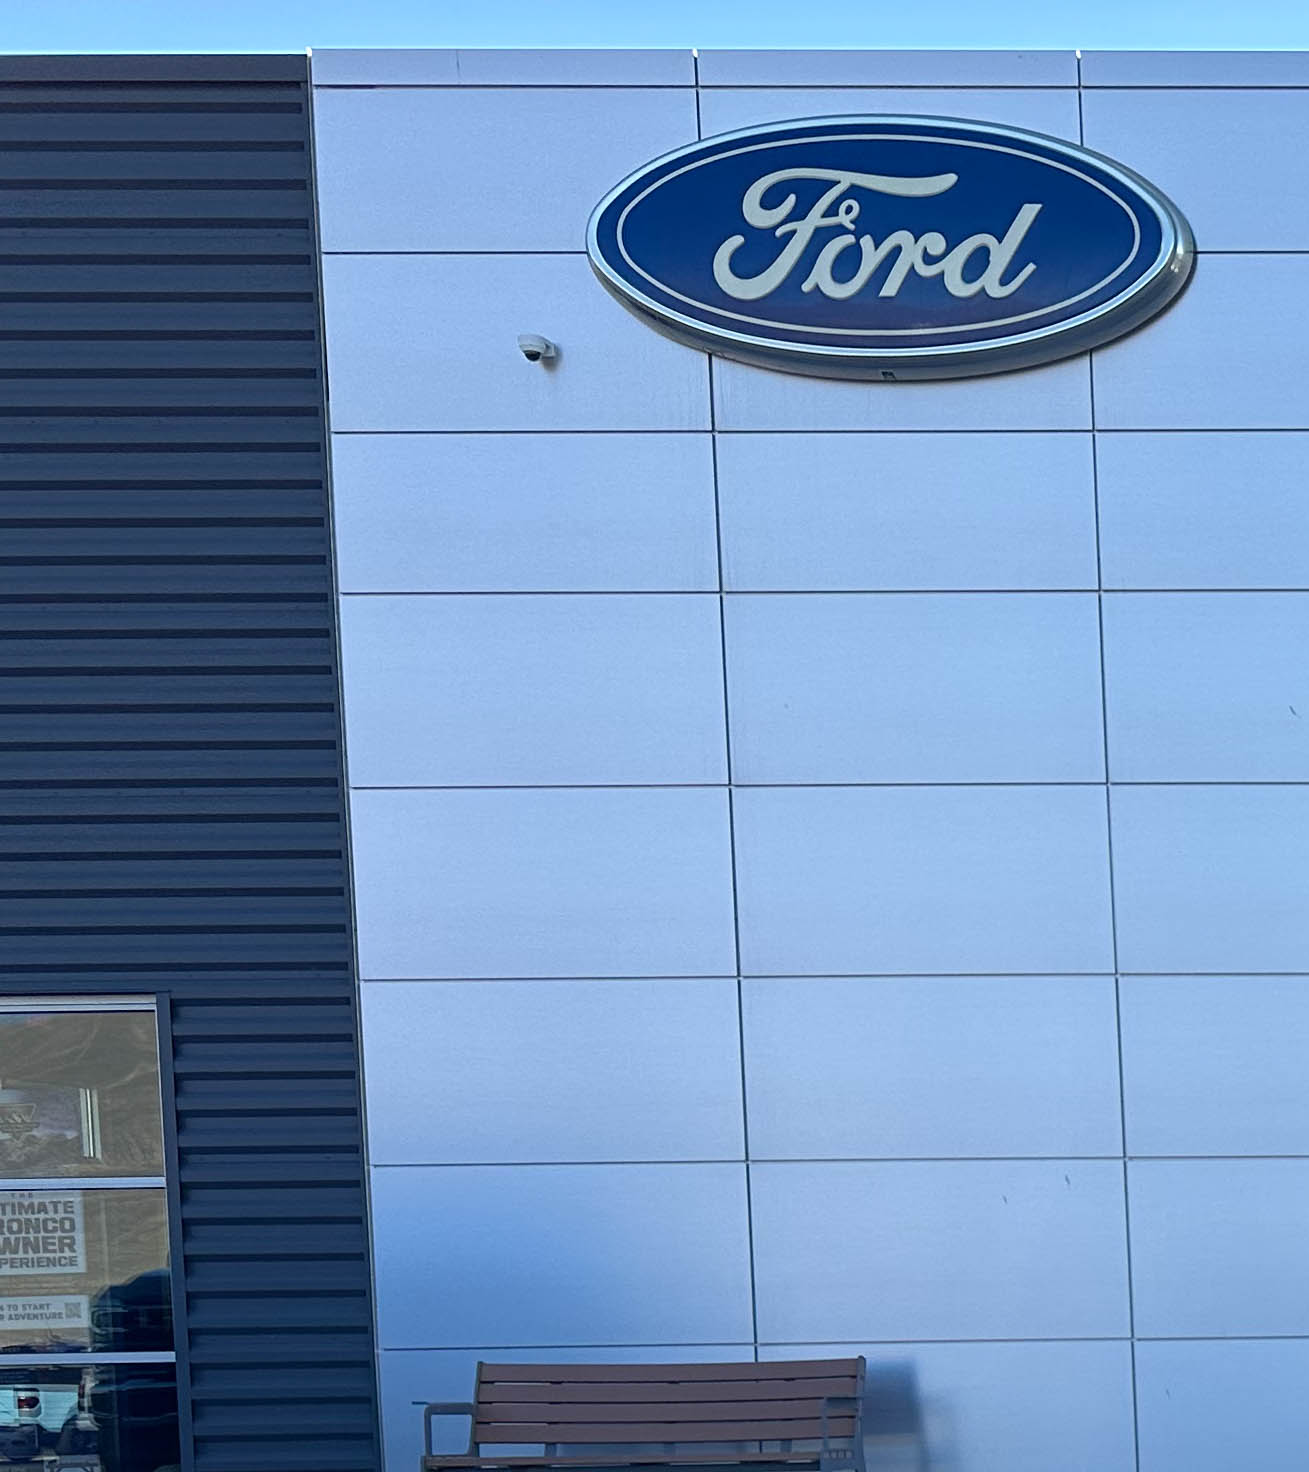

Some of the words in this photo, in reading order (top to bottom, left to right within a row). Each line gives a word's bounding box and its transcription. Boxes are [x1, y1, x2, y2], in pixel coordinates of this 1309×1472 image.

[713, 166, 1043, 300] Ford
[22, 1303, 50, 1311] START
[8, 1312, 64, 1321] ADVENTURE
